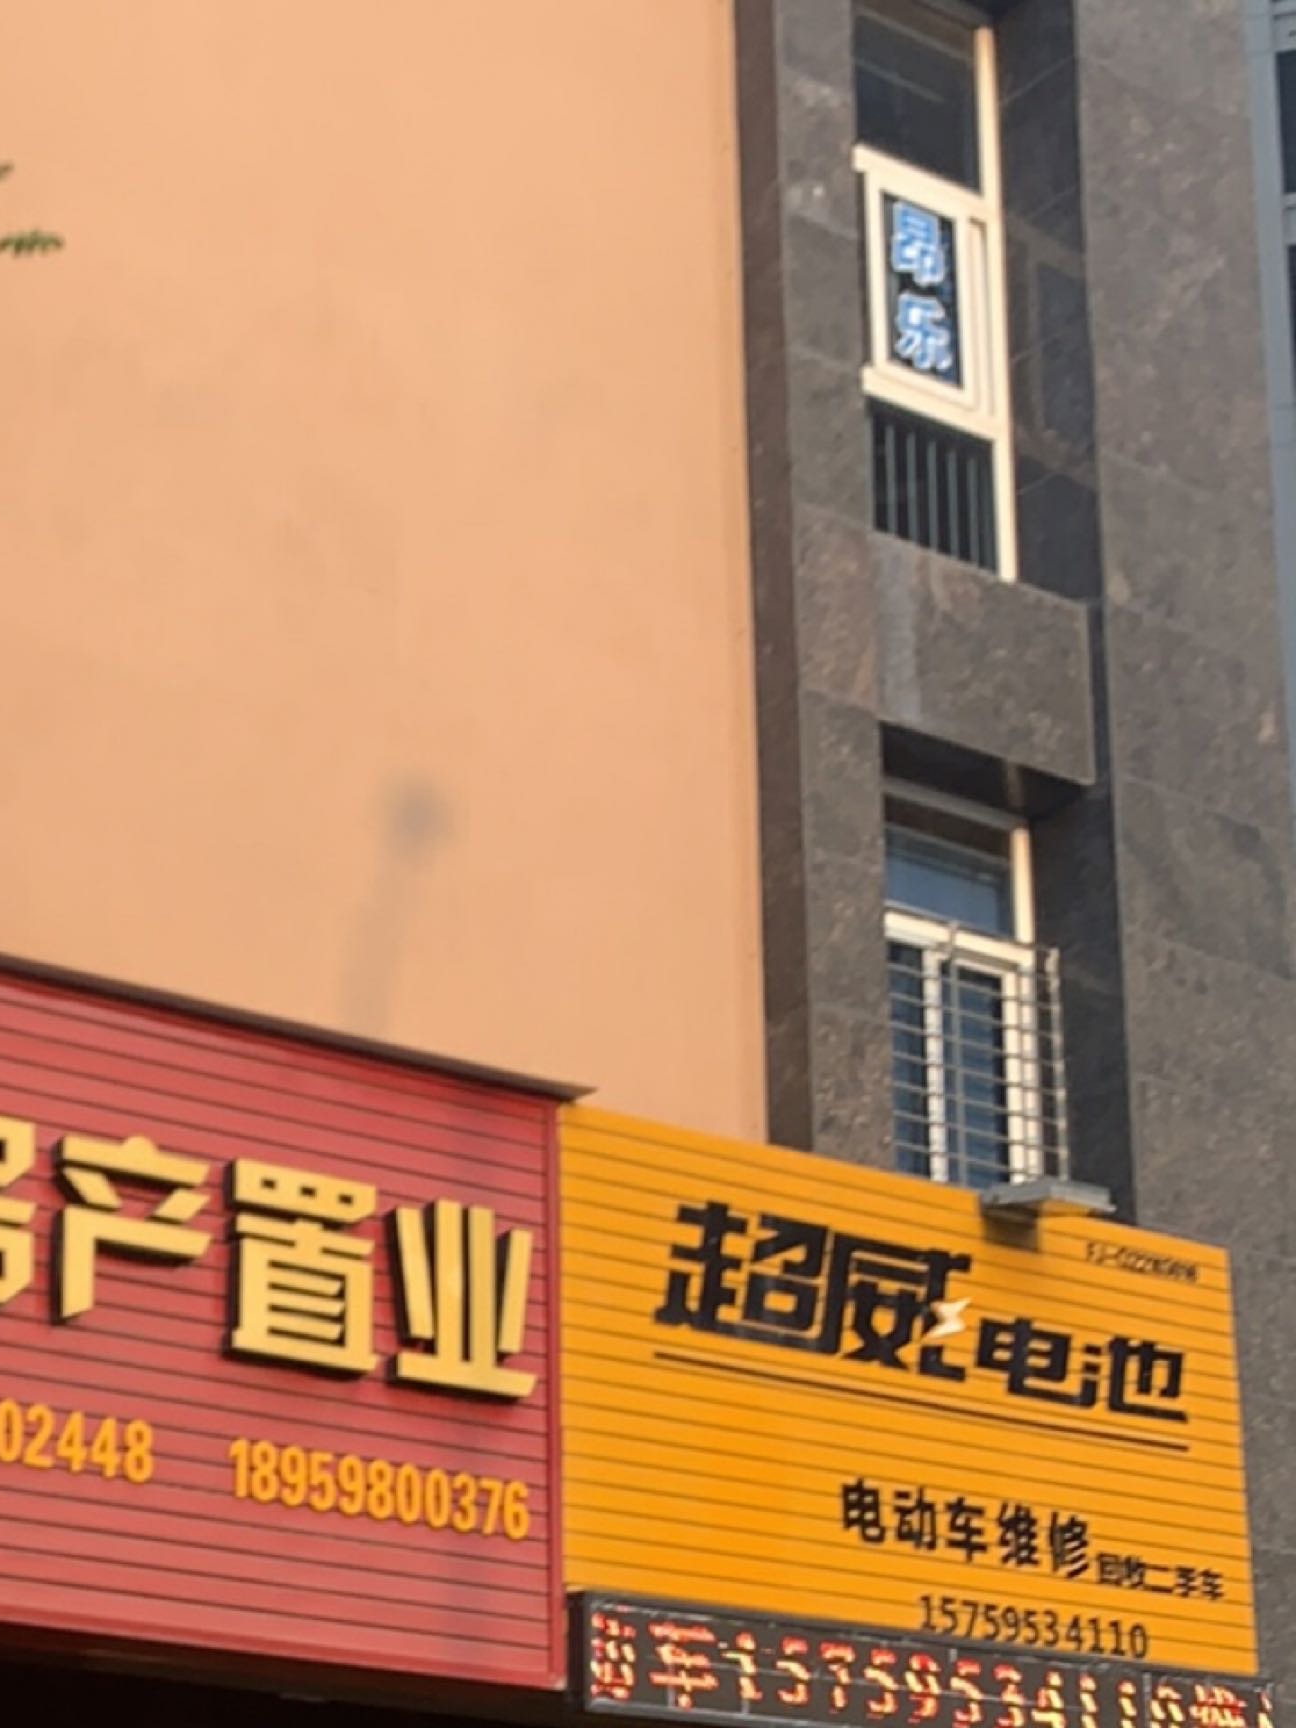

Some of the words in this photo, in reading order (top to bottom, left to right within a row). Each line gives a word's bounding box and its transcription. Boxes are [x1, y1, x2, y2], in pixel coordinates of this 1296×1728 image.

[653, 1199, 1190, 1425] 超威电池
[228, 1437, 531, 1541] 18959800376
[840, 1478, 1090, 1580] 电动车维修
[1095, 1550, 1225, 1602] 回收二手车
[919, 1595, 1150, 1660] 15759534110
